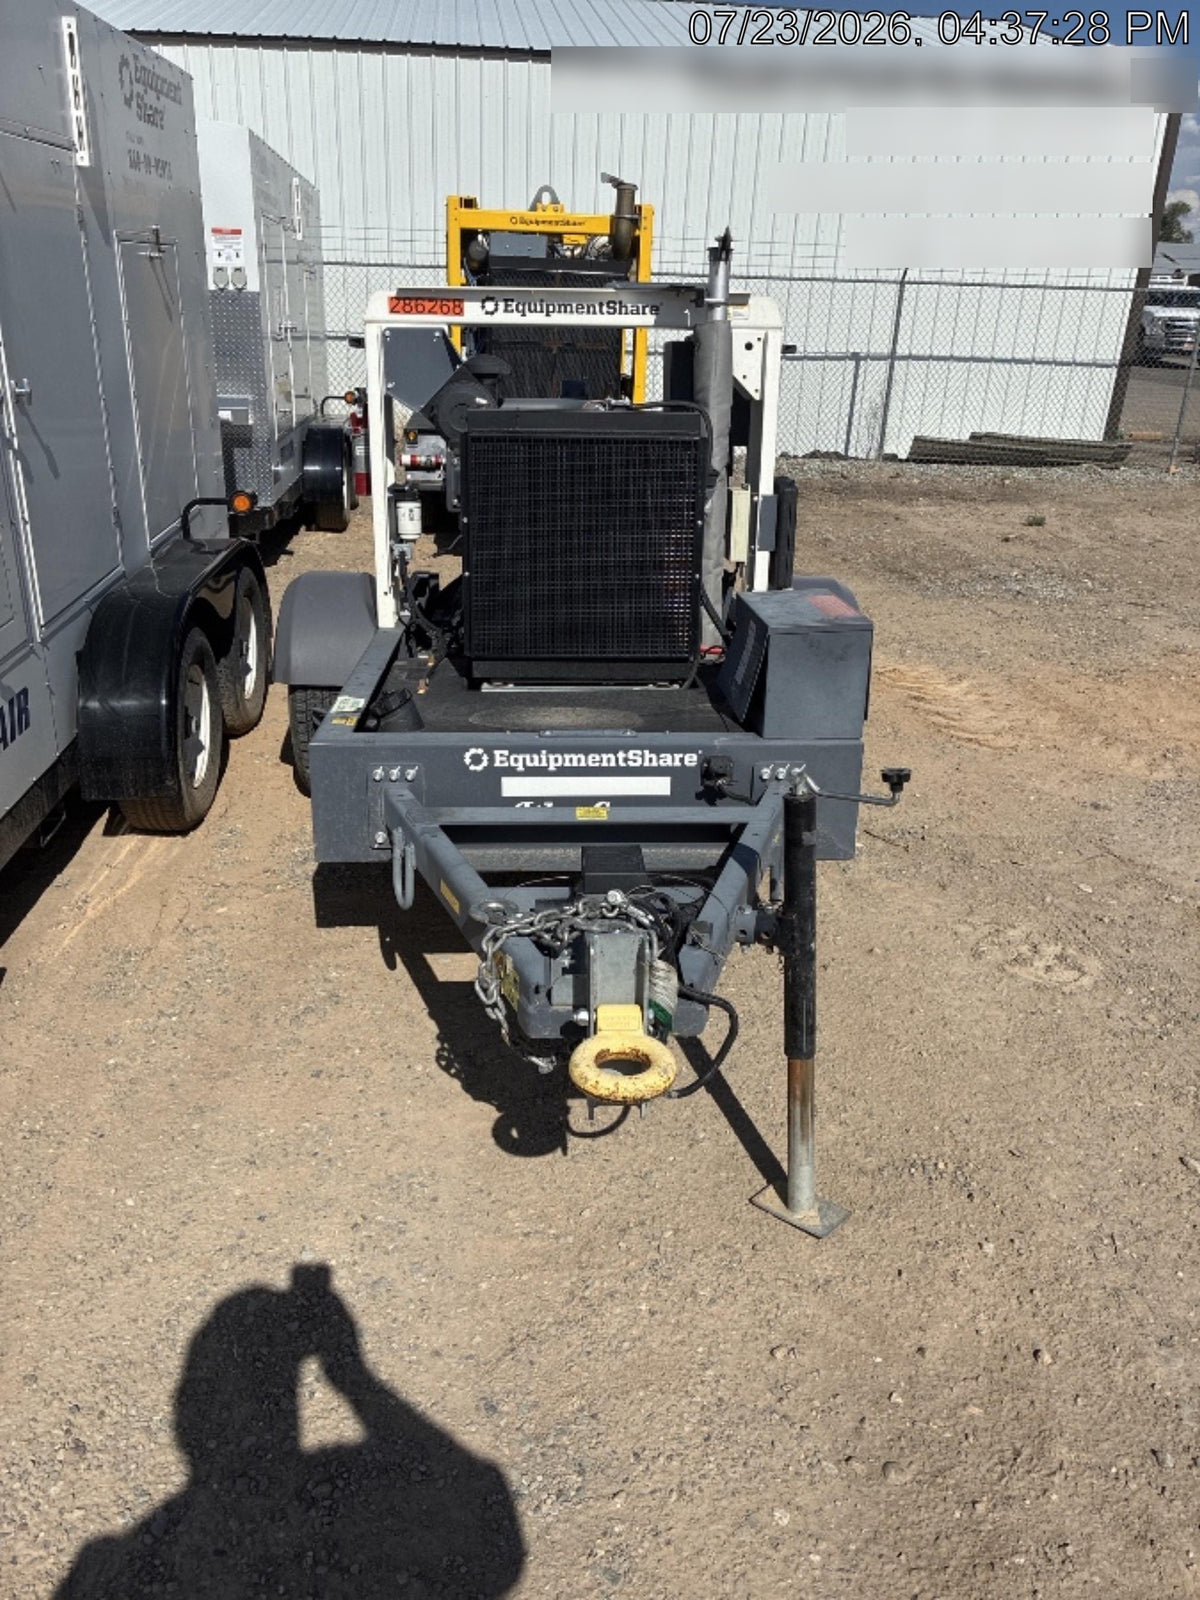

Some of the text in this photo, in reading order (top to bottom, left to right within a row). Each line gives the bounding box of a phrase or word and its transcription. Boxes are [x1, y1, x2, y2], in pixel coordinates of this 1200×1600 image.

[389, 296, 463, 315] 286268
[503, 299, 661, 317] EquipmentShare
[493, 749, 699, 771] EquipmentShare
